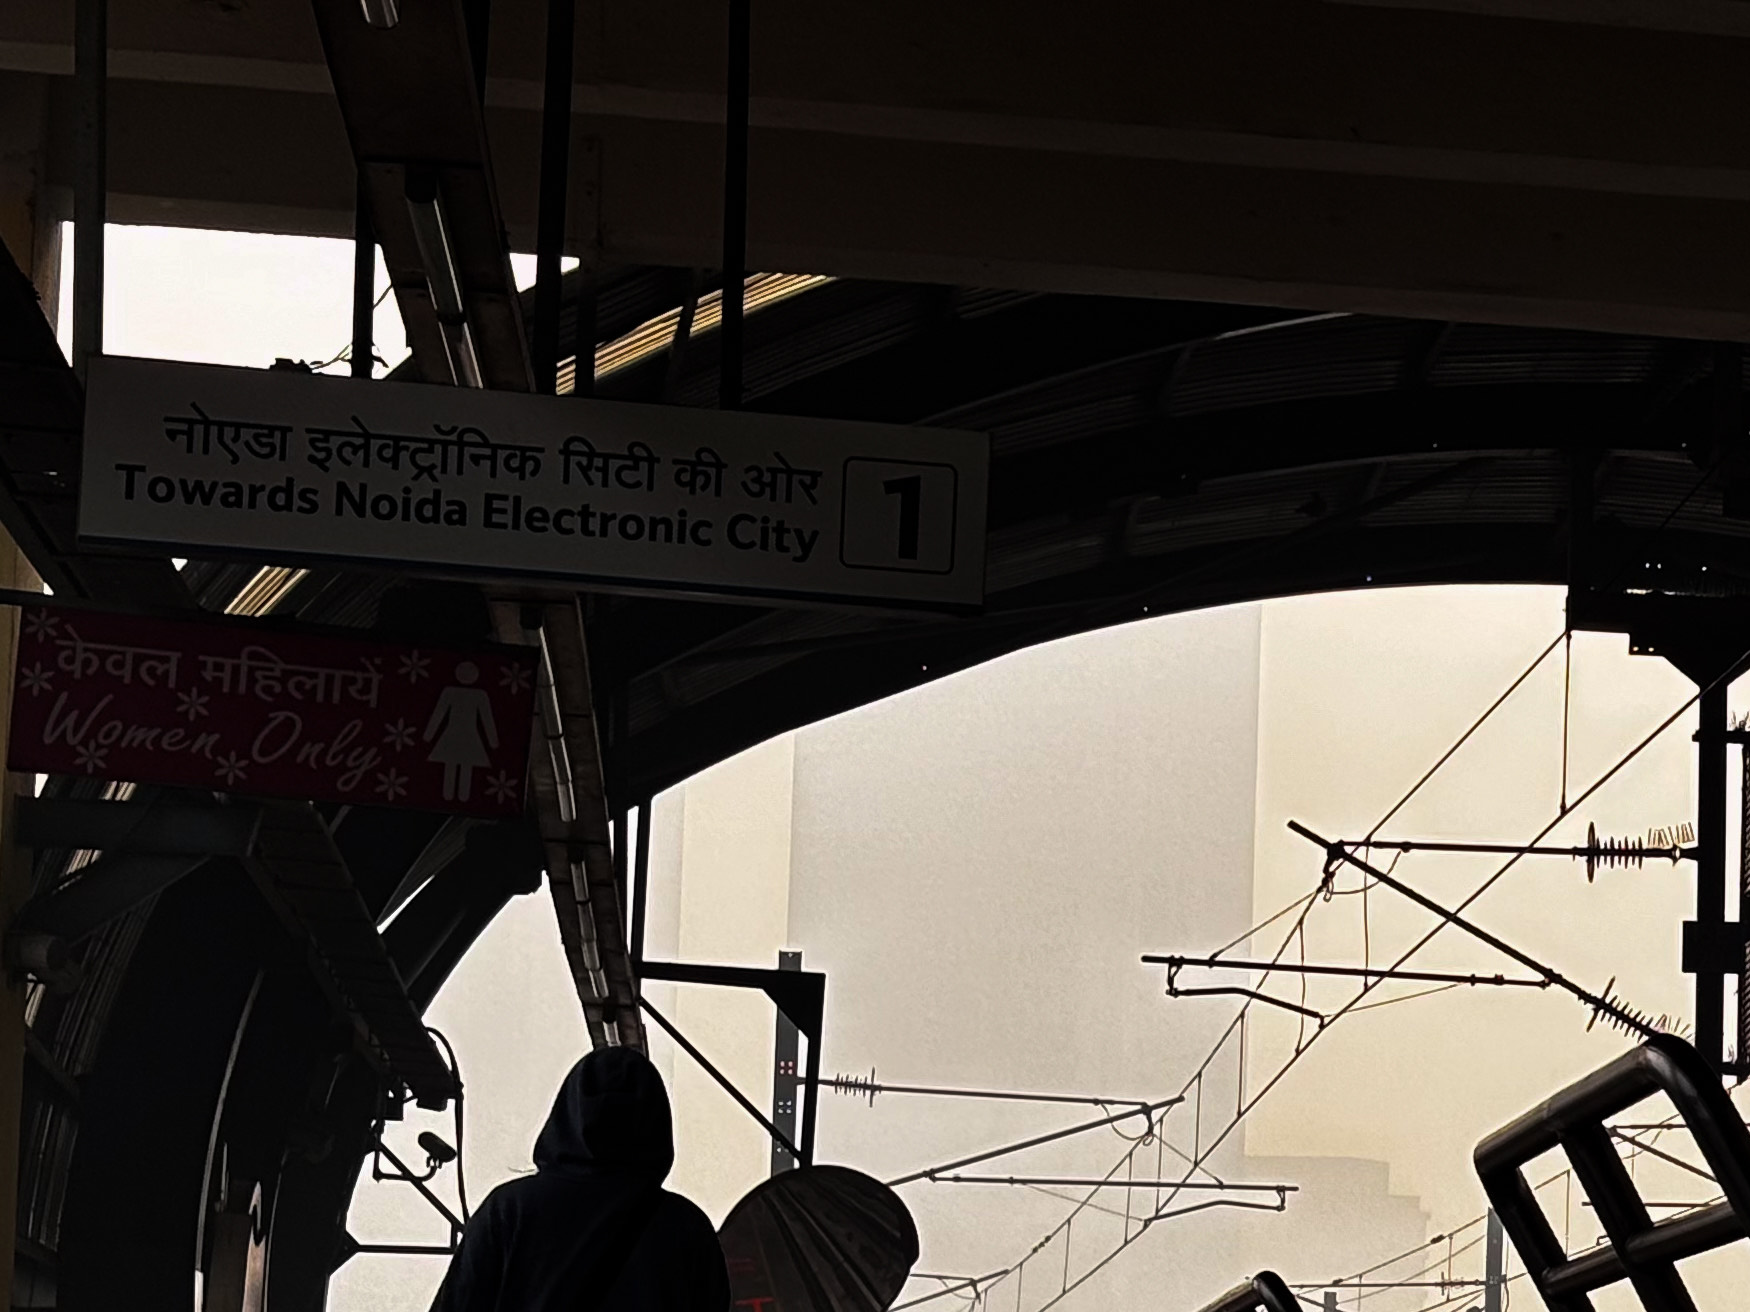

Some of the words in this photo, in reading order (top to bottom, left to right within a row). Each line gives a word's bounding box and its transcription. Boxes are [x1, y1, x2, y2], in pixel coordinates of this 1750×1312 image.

[164, 402, 293, 464] नोएडा
[305, 416, 545, 482] इलेक्ट्रॉनिक
[559, 436, 660, 491] सिटी
[672, 447, 728, 498] की
[741, 452, 822, 504] ओर
[116, 464, 319, 515] Towards
[335, 481, 467, 527] Noida
[483, 493, 713, 547] Electronic
[726, 514, 819, 563] City
[883, 476, 921, 560] 1
[55, 624, 182, 690] केवल
[199, 646, 384, 709] महिलायें
[43, 691, 223, 759] Women
[251, 710, 384, 792] Only
